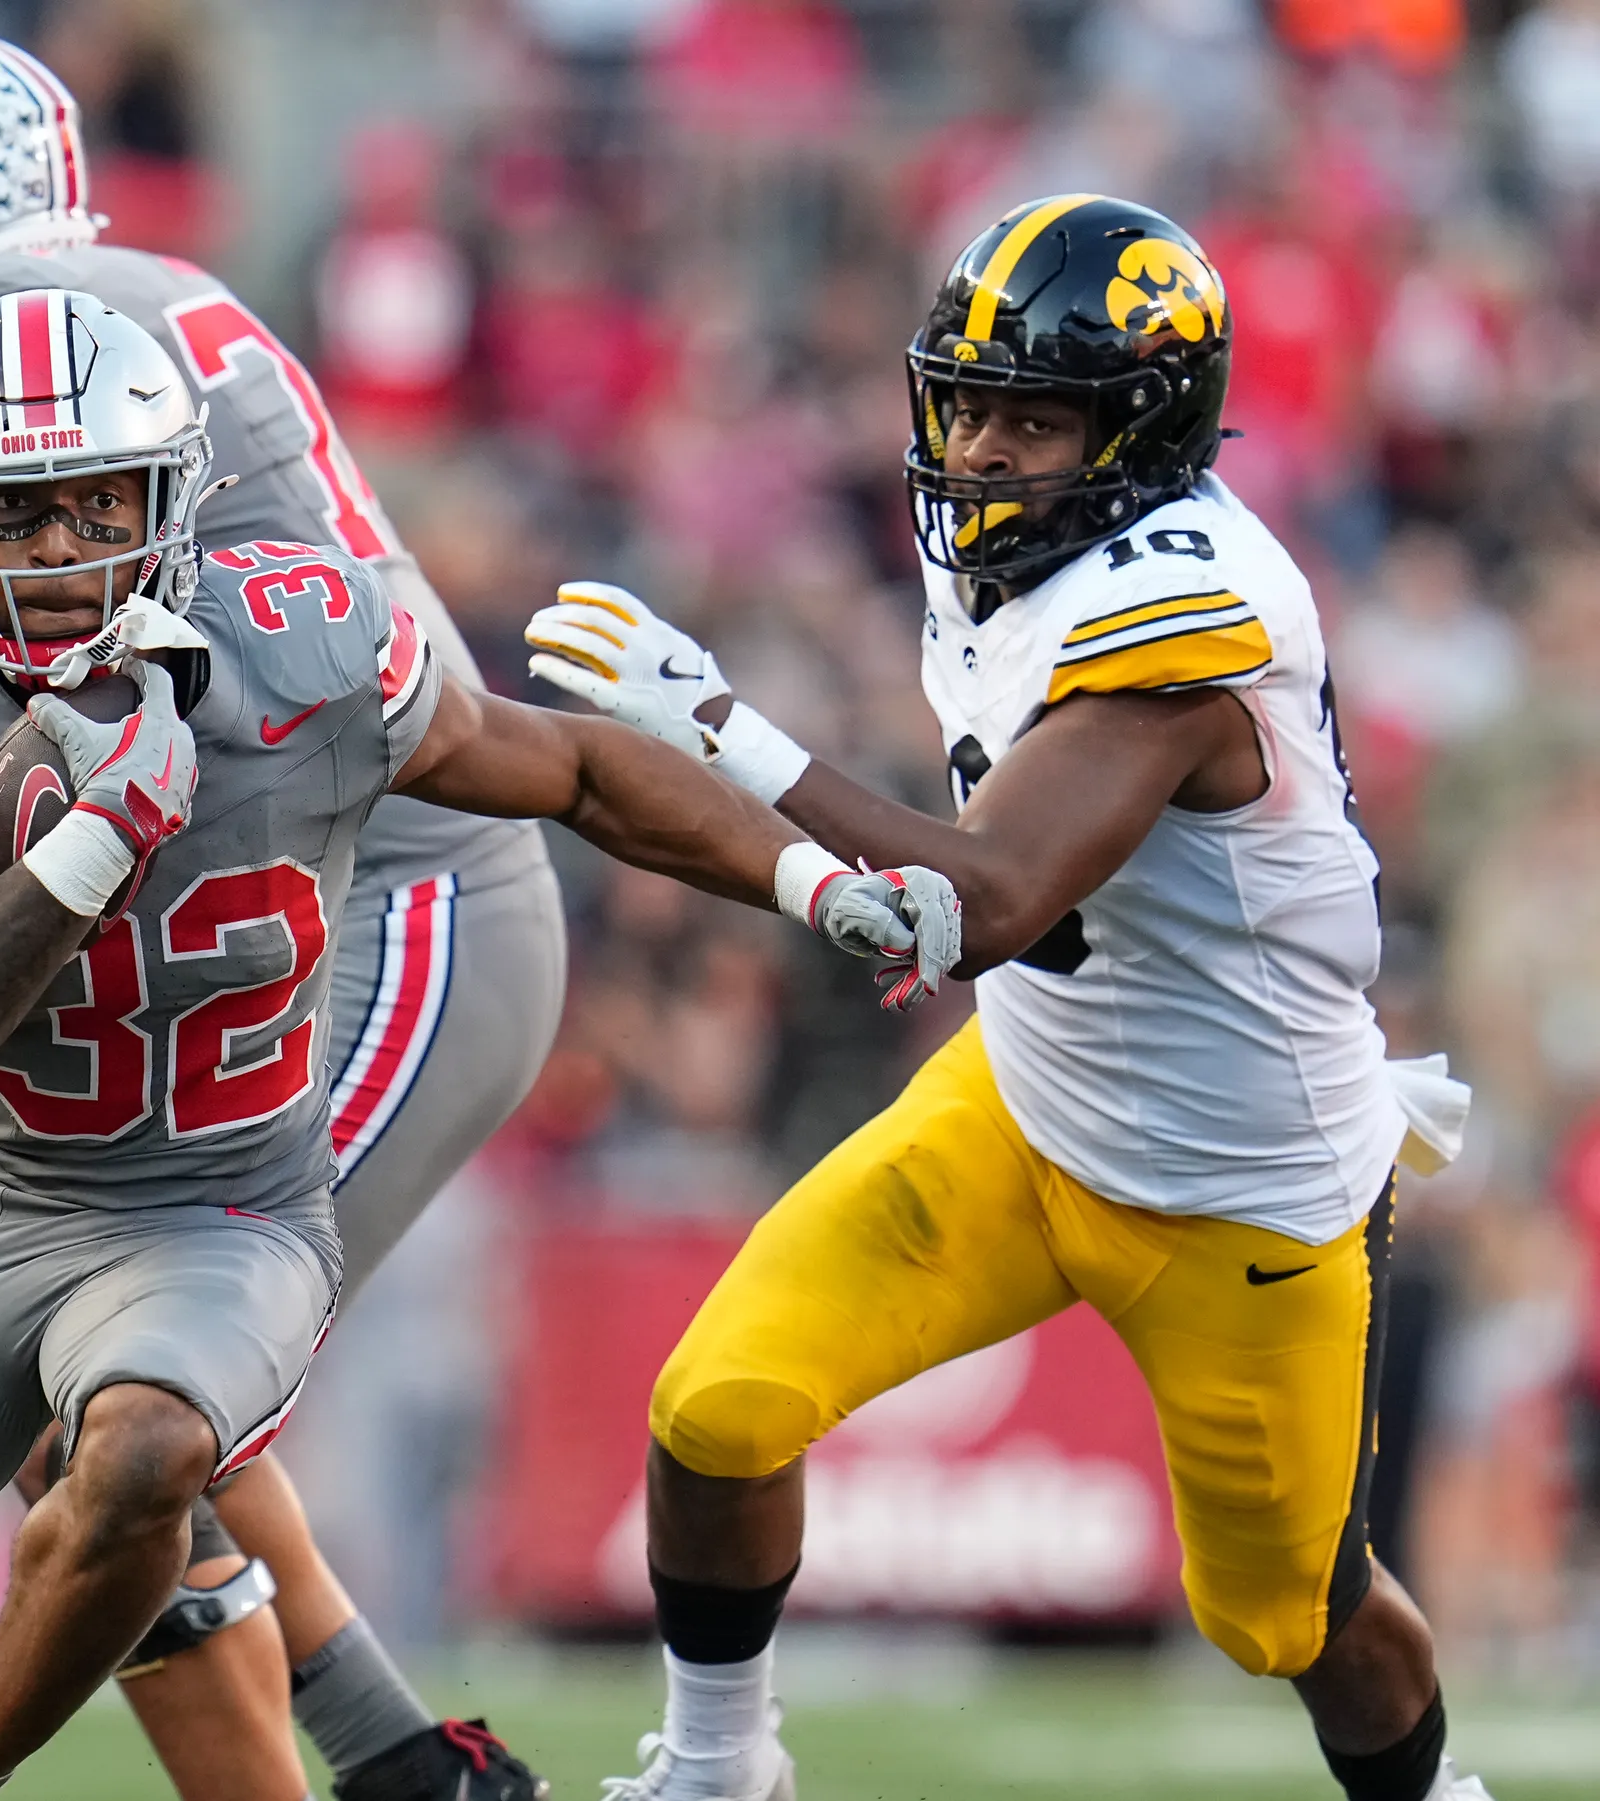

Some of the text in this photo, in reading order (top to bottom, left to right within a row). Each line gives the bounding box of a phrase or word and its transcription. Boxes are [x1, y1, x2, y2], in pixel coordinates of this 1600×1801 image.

[1, 429, 83, 455] OHIO STATE
[75, 518, 115, 541] 10:9
[1102, 529, 1215, 571] 10
[140, 553, 160, 581] OHIO
